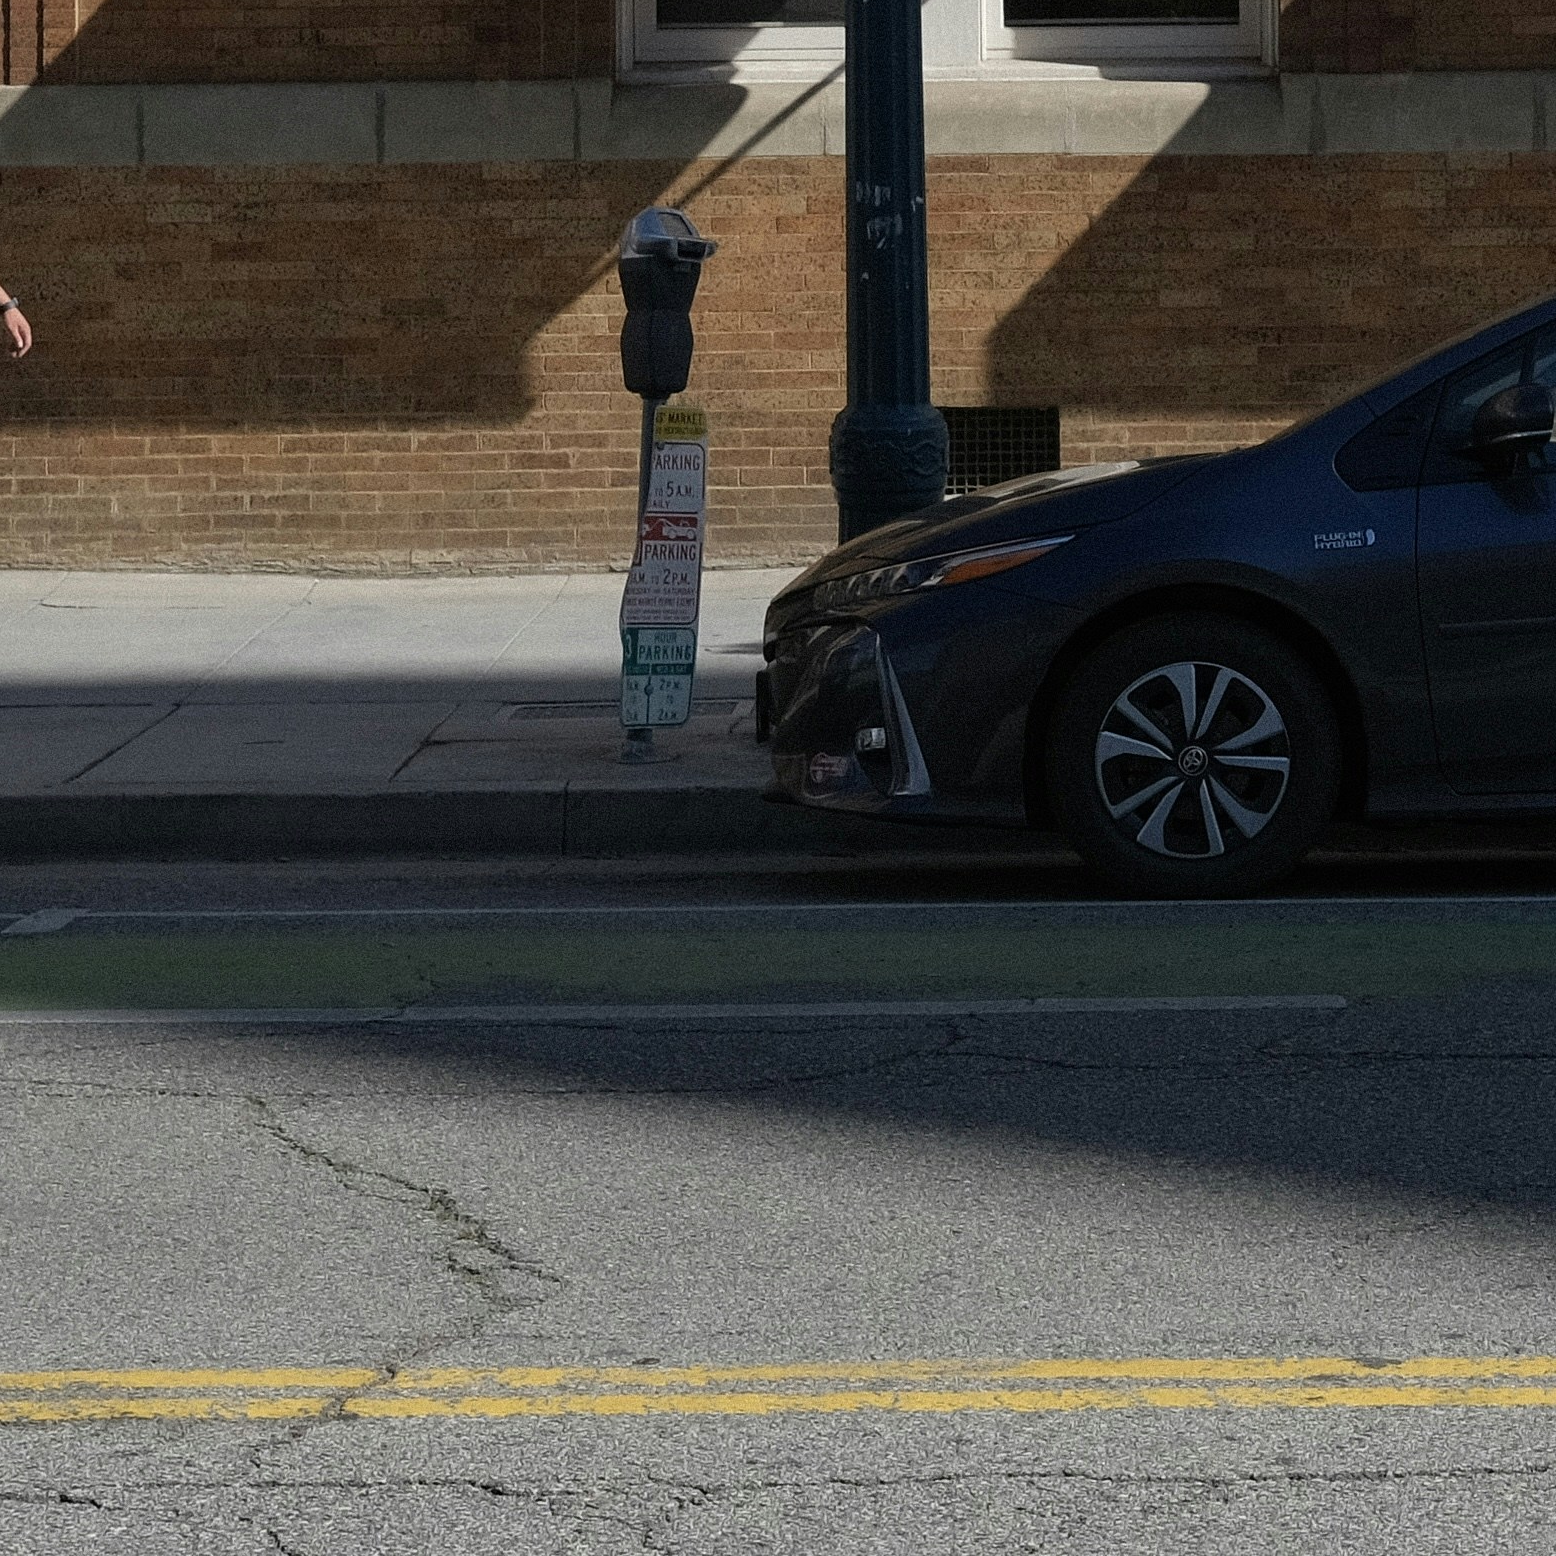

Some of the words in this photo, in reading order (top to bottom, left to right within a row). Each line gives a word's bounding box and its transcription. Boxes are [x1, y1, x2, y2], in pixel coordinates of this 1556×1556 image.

[668, 411, 703, 425] MARKET
[653, 454, 701, 471] ARKING
[1314, 539, 1362, 549] HYBRID
[644, 544, 697, 561] PARKING
[654, 631, 677, 644] HOUR
[638, 645, 692, 661] PARKING
